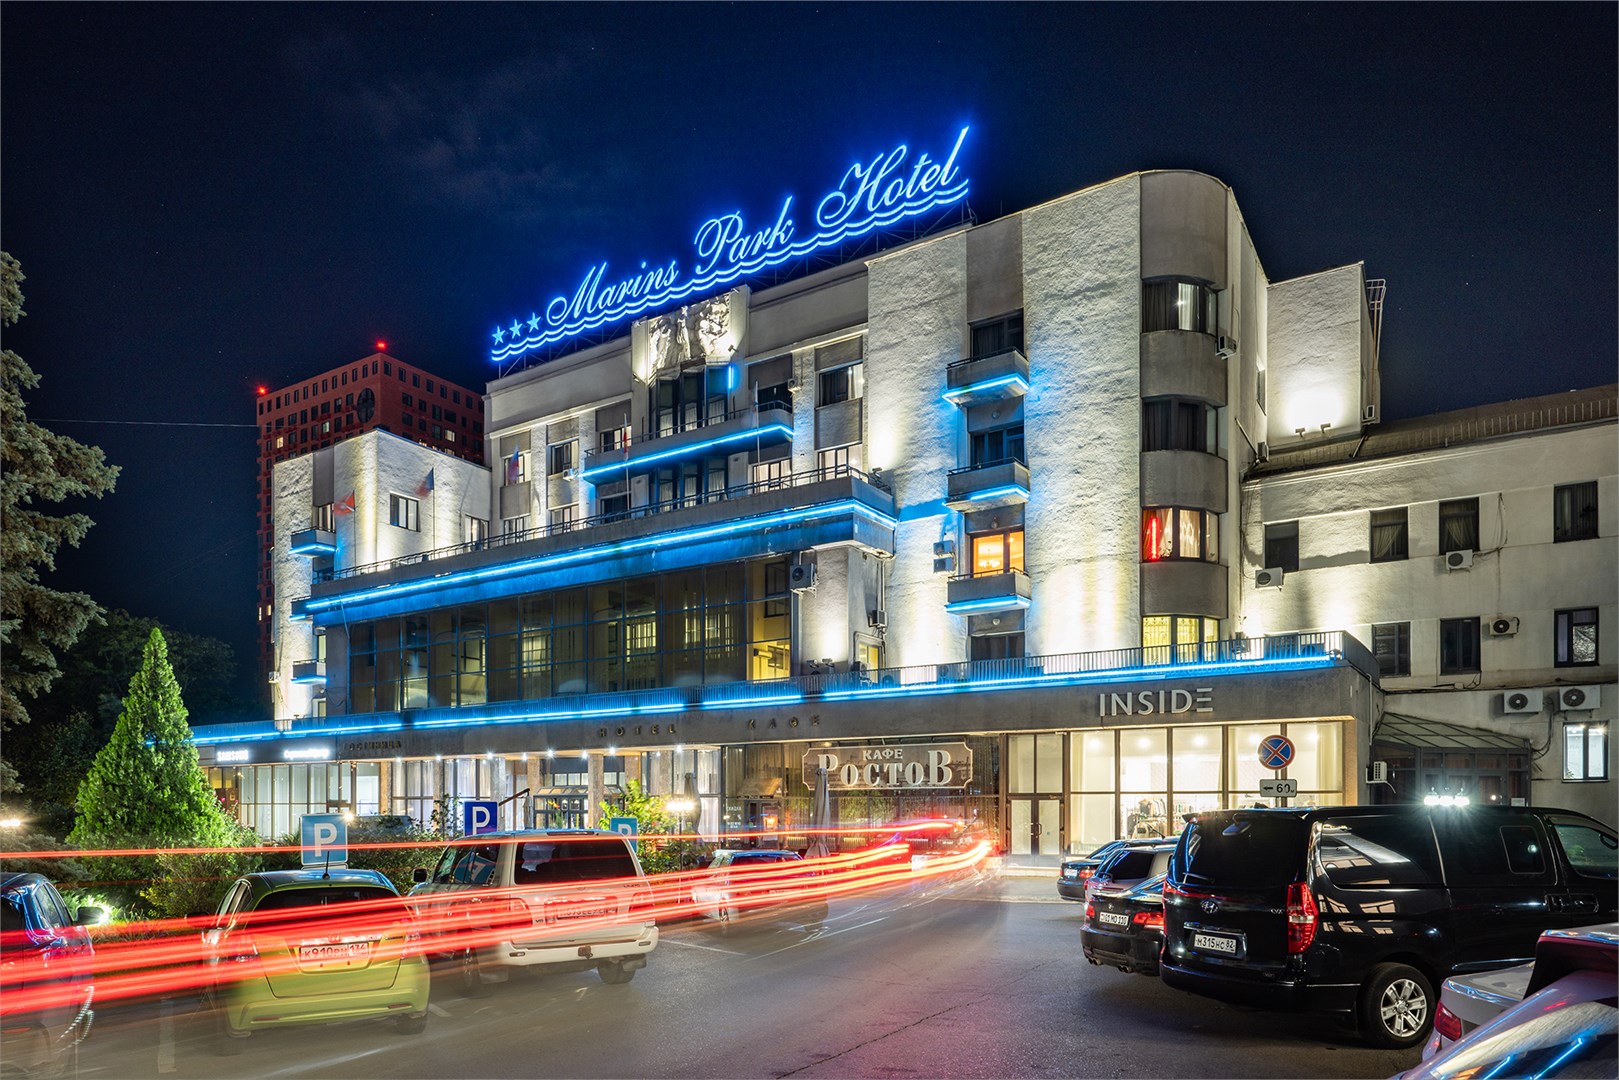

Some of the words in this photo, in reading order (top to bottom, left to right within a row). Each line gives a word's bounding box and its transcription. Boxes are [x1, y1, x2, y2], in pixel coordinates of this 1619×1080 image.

[547, 261, 679, 327] Marins
[694, 195, 795, 273] Park
[816, 125, 970, 227] Hotel
[1100, 687, 1213, 717] INSIDE
[599, 724, 676, 737] HOTEL
[862, 748, 903, 760] КАФЕ
[472, 806, 490, 835] P
[314, 823, 337, 857] P
